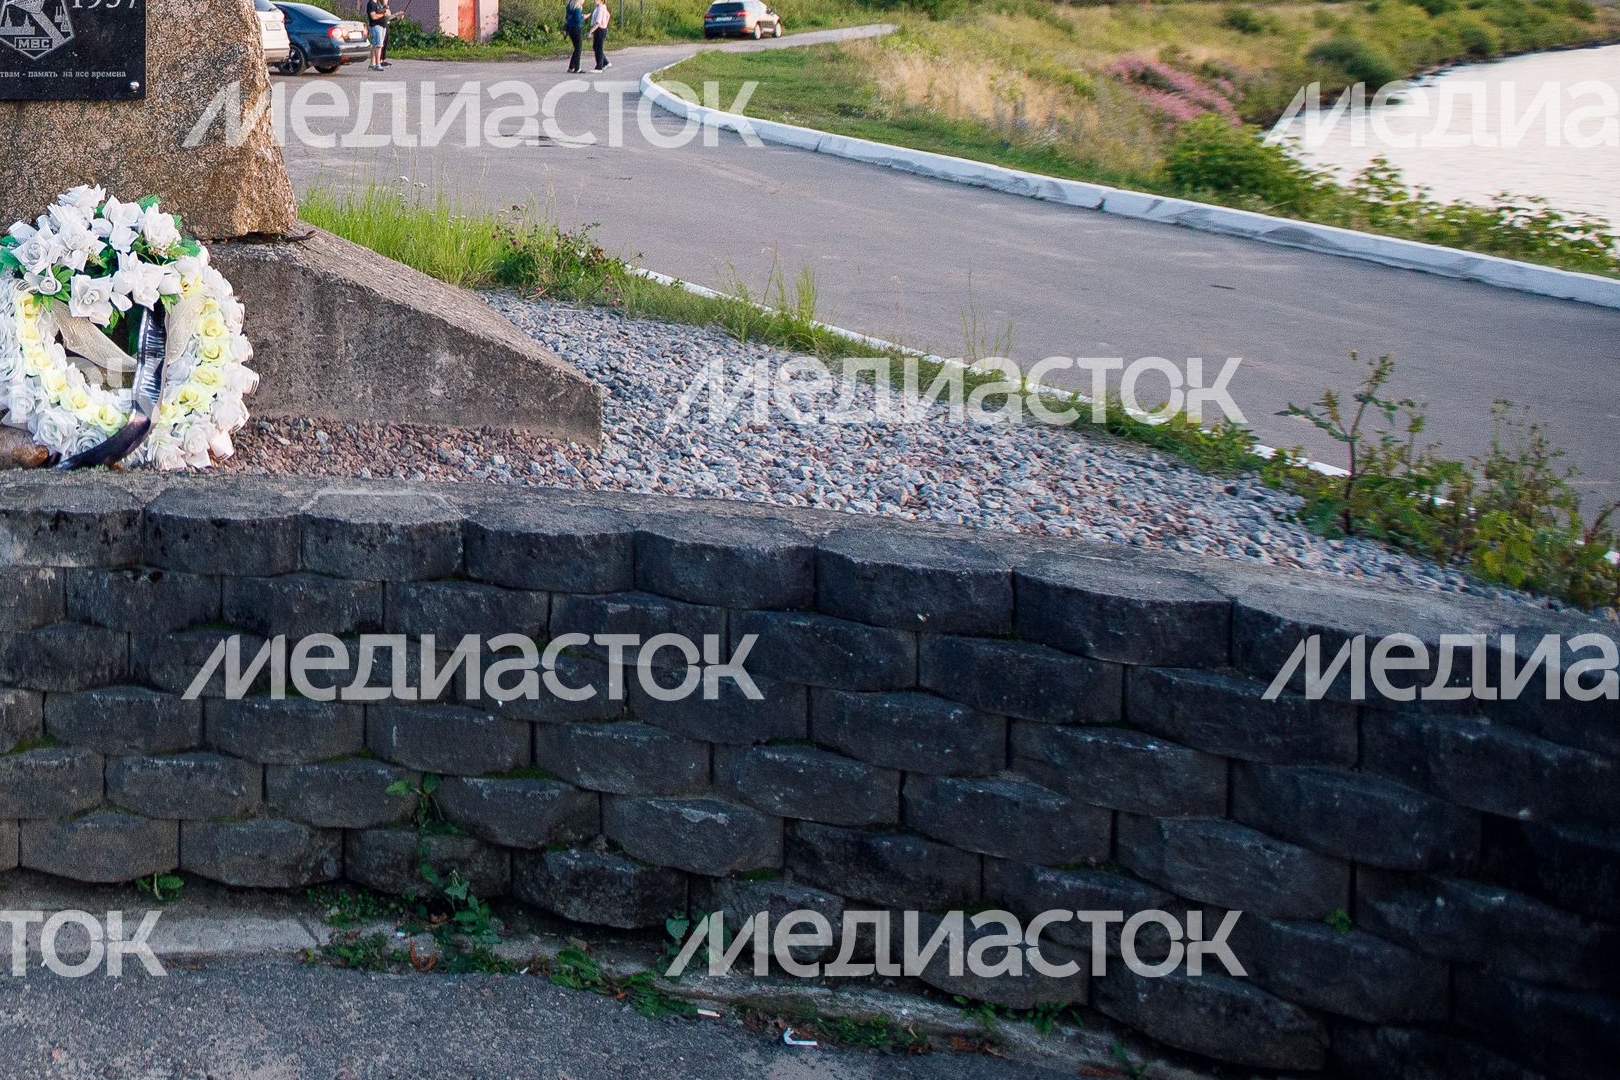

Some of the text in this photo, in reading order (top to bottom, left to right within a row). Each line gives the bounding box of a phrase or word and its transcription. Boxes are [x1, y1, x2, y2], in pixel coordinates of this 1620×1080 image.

[18, 39, 51, 49] МВС
[28, 70, 58, 78] память
[62, 69, 73, 78] на
[75, 70, 89, 78] все
[91, 70, 127, 80] времена
